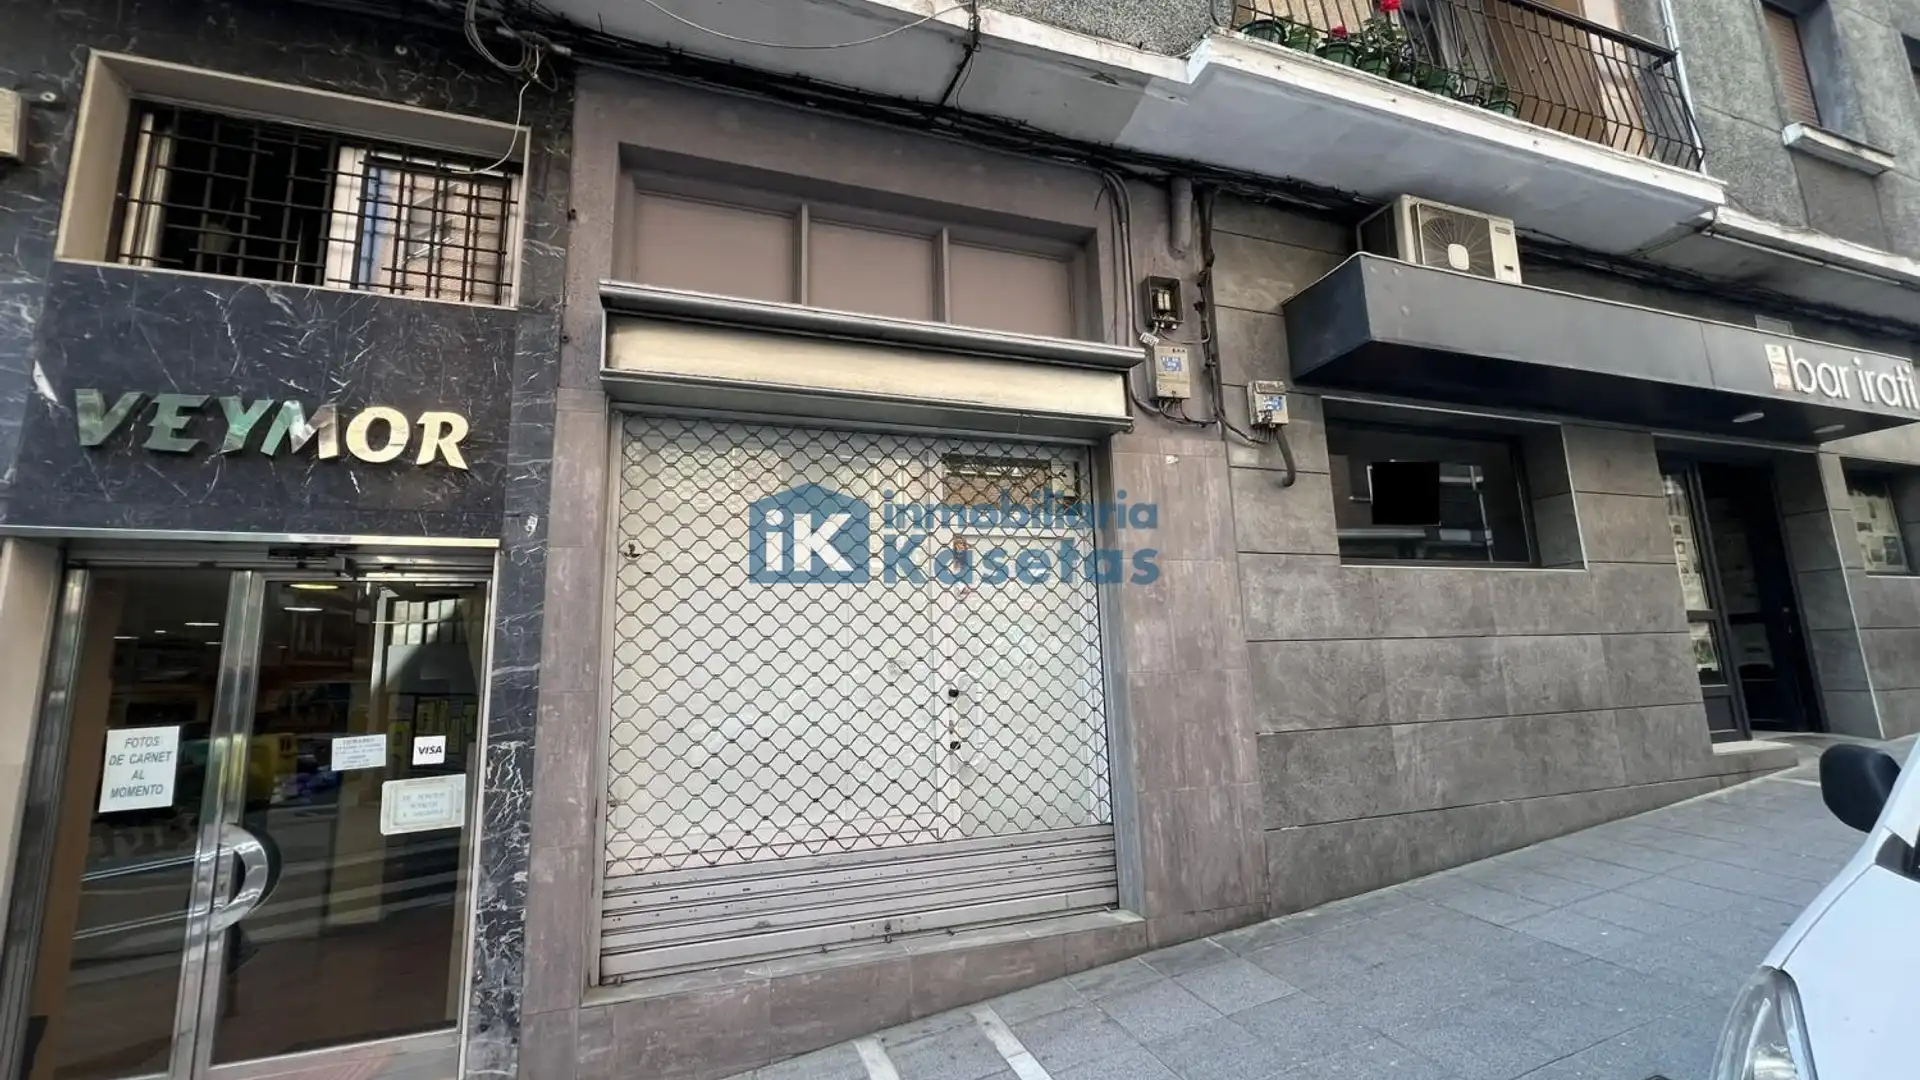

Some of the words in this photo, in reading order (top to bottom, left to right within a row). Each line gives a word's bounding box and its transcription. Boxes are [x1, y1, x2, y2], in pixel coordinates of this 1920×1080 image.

[1787, 344, 1850, 399] bar
[1852, 357, 1920, 410] irati
[74, 388, 470, 470] VEYMOR
[124, 735, 161, 749] FOTOS
[418, 744, 444, 756] VISA
[108, 753, 125, 766] DE
[129, 750, 173, 765] CARNET
[131, 769, 145, 780] AL
[110, 783, 164, 799] MOMENTO
